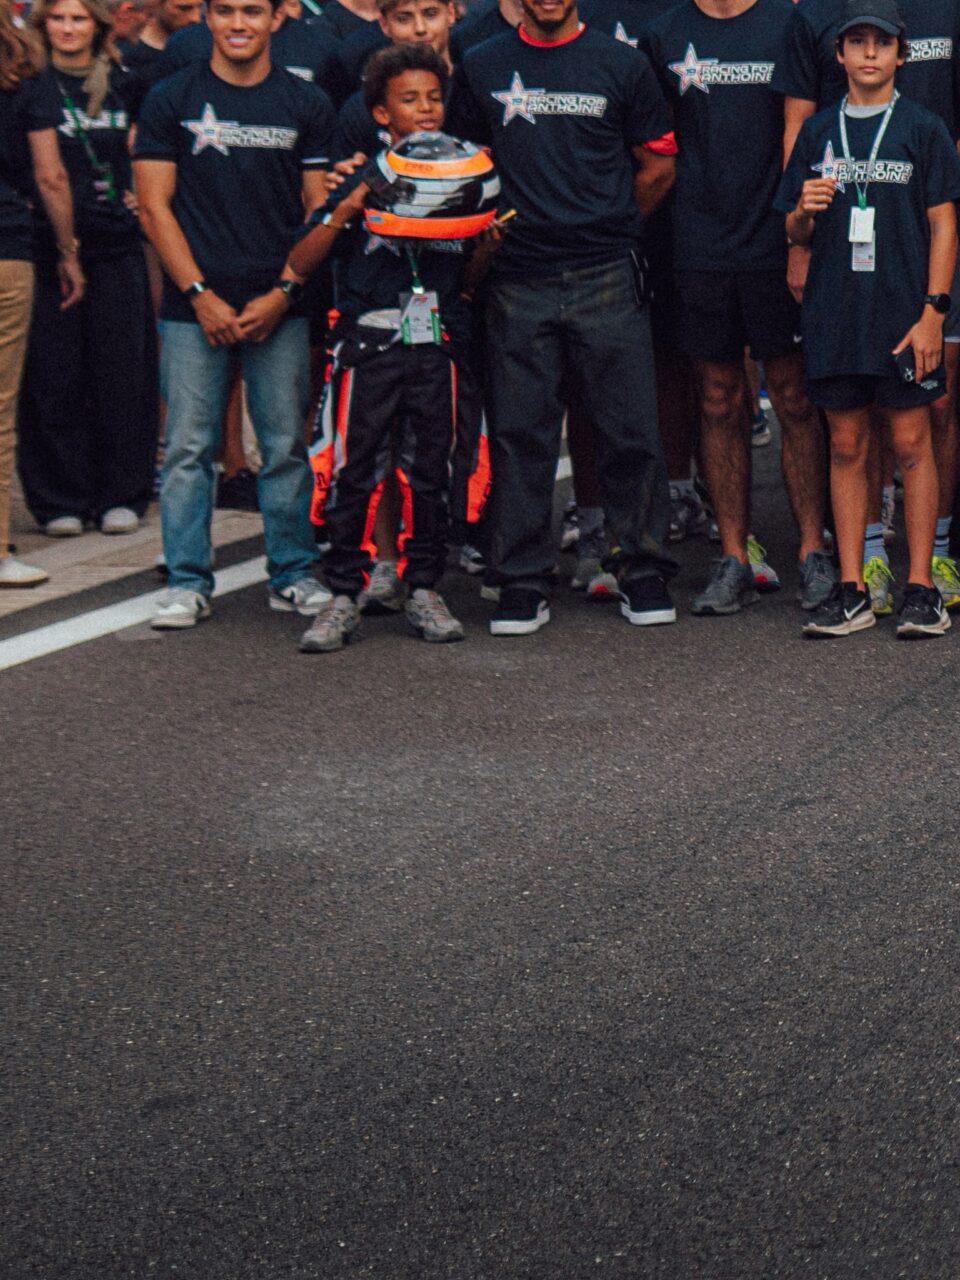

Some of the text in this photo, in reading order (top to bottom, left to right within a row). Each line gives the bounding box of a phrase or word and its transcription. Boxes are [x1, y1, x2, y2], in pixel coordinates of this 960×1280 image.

[910, 48, 951, 60] HOINE
[701, 64, 749, 75] RACING
[528, 95, 606, 109] RACING FOR
[527, 103, 603, 115] ANTHOINE
[838, 163, 911, 174] RCIG FOR
